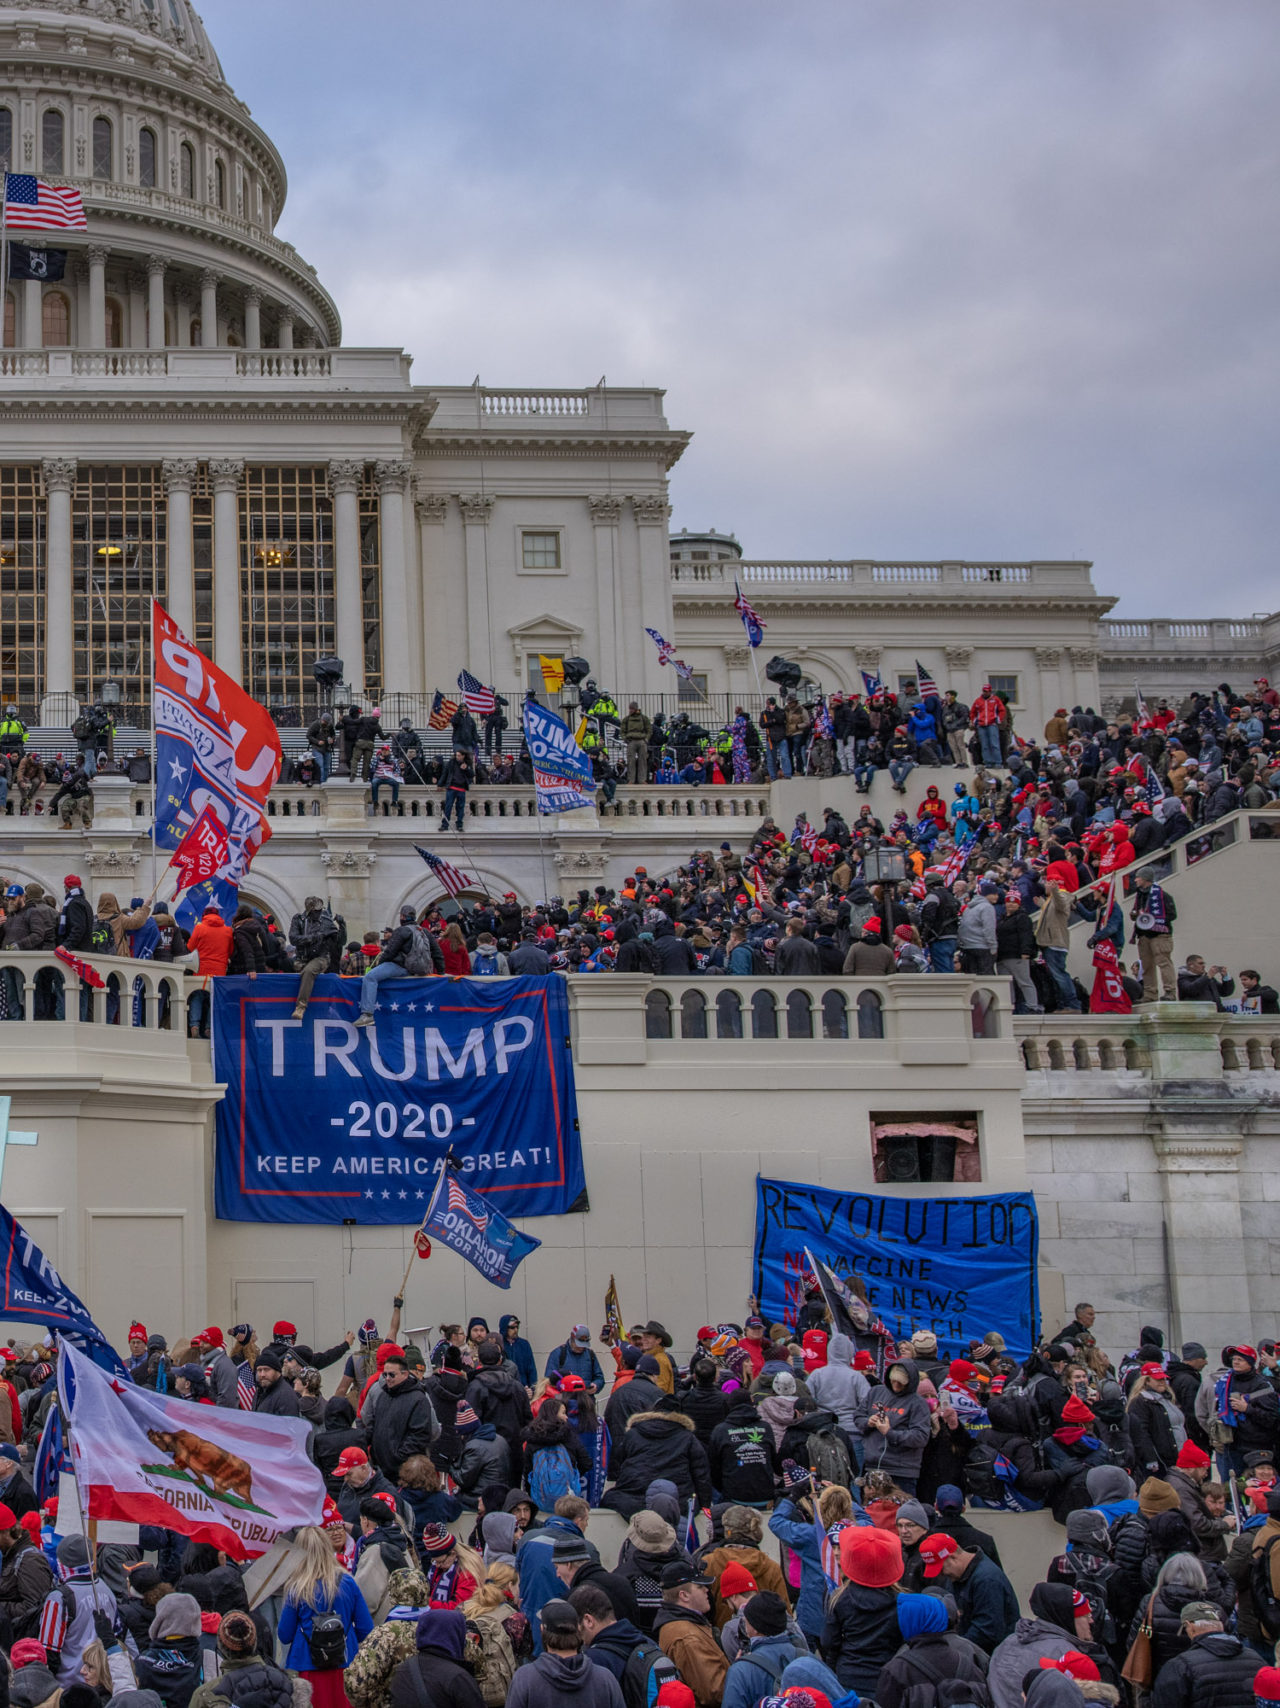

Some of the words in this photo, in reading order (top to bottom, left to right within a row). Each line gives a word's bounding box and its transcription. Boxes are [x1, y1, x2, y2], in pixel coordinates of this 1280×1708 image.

[254, 1015, 534, 1082] TRUMP
[257, 1155, 321, 1173] KEEP
[332, 1157, 452, 1175] AMERICA
[460, 1147, 552, 1172] GREAT!
[446, 1232, 472, 1254] FOR
[825, 1254, 933, 1281] VACCINE
[892, 1286, 969, 1313] NEWS
[894, 1314, 963, 1339] TECH
[81, 1592, 110, 1611] TRMP
